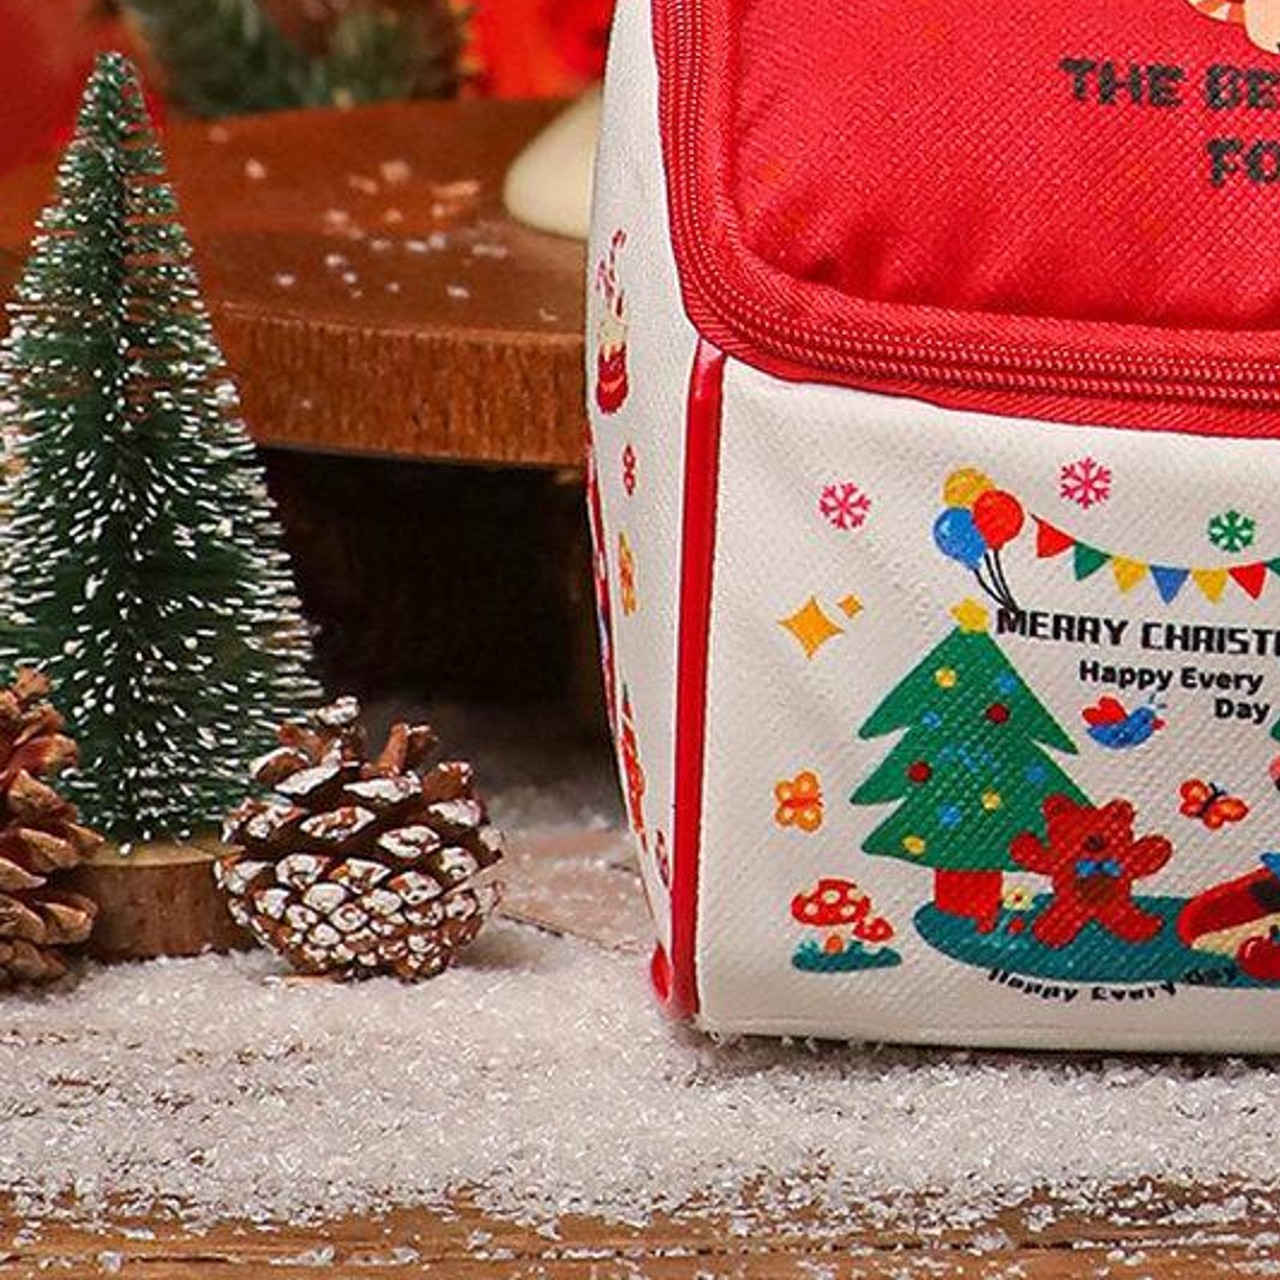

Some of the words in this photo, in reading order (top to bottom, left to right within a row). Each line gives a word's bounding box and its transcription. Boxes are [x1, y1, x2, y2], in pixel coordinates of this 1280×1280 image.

[1060, 57, 1184, 108] THE
[996, 607, 1129, 646] MERRY
[1078, 660, 1173, 691] Happy
[1180, 667, 1264, 695] Every
[1214, 698, 1270, 724] Day
